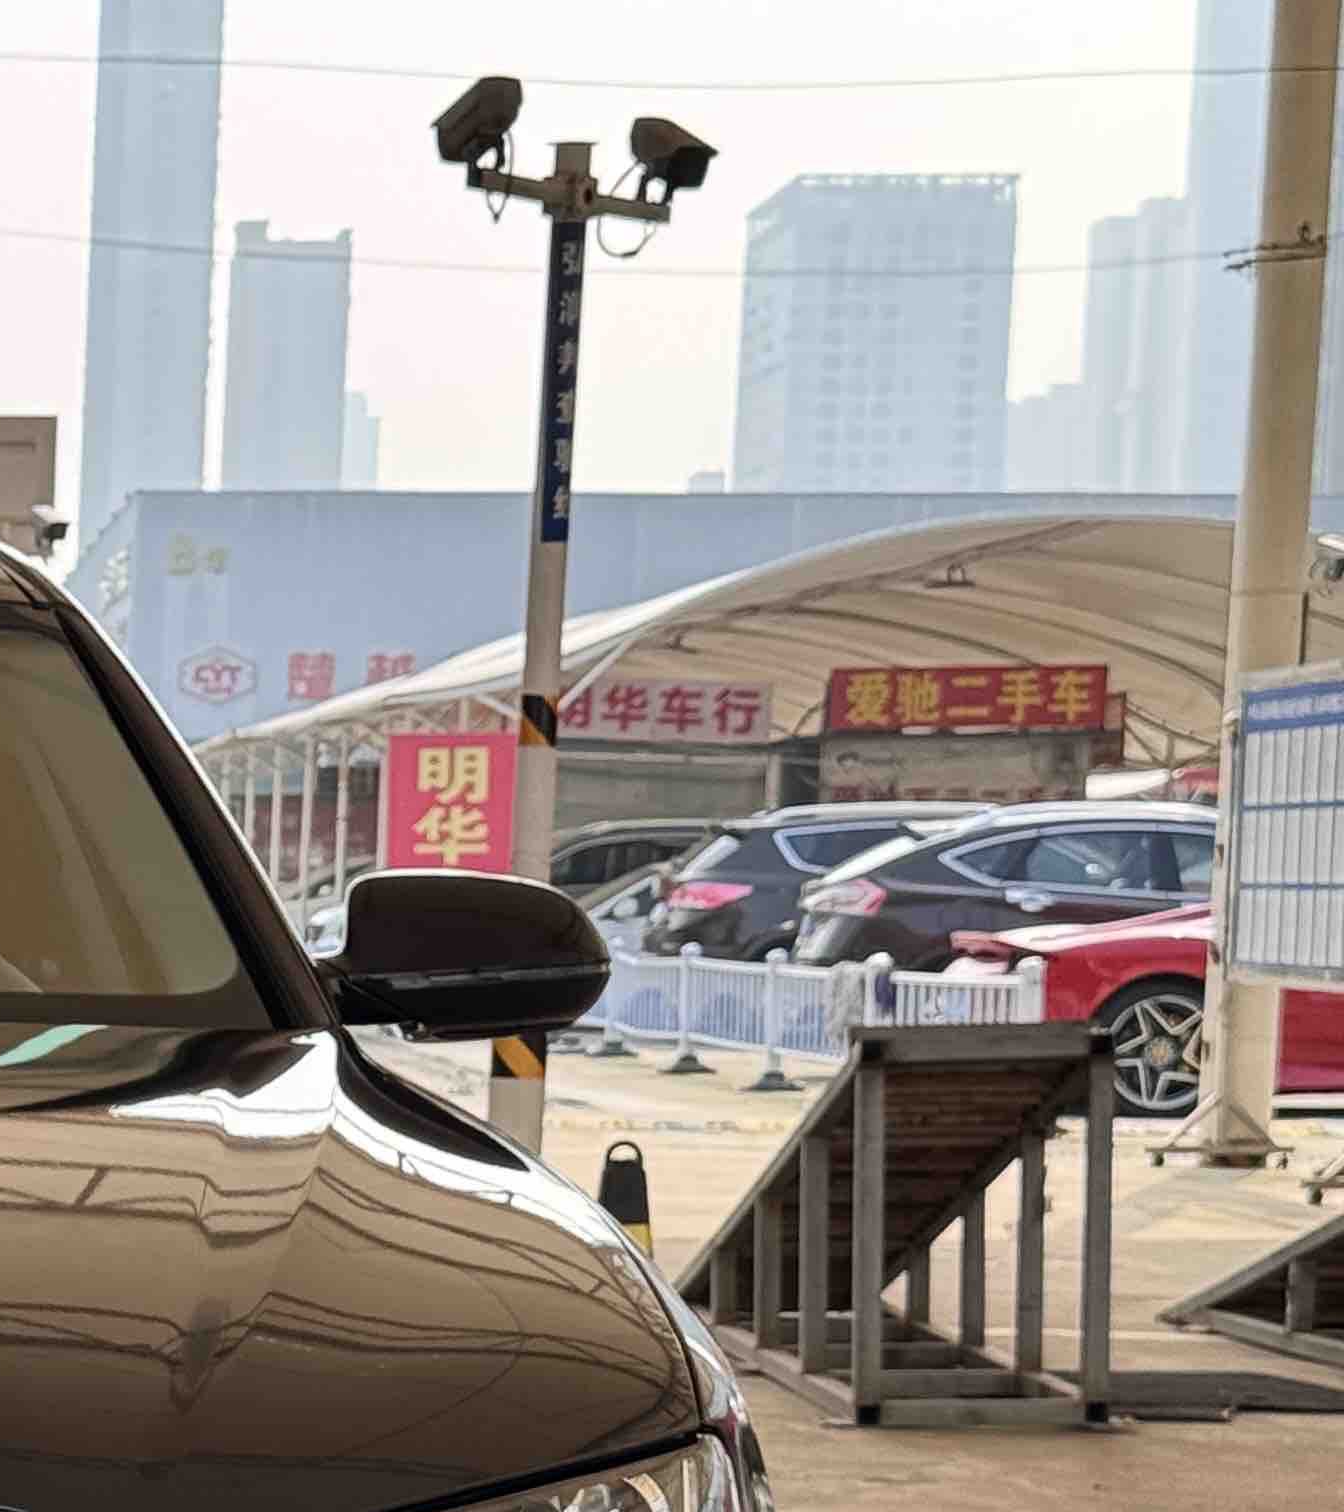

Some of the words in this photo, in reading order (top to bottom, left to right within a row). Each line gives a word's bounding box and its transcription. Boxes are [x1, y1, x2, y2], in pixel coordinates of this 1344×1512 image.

[846, 671, 1096, 725] 爱驰二手车
[413, 747, 490, 866] 明华
